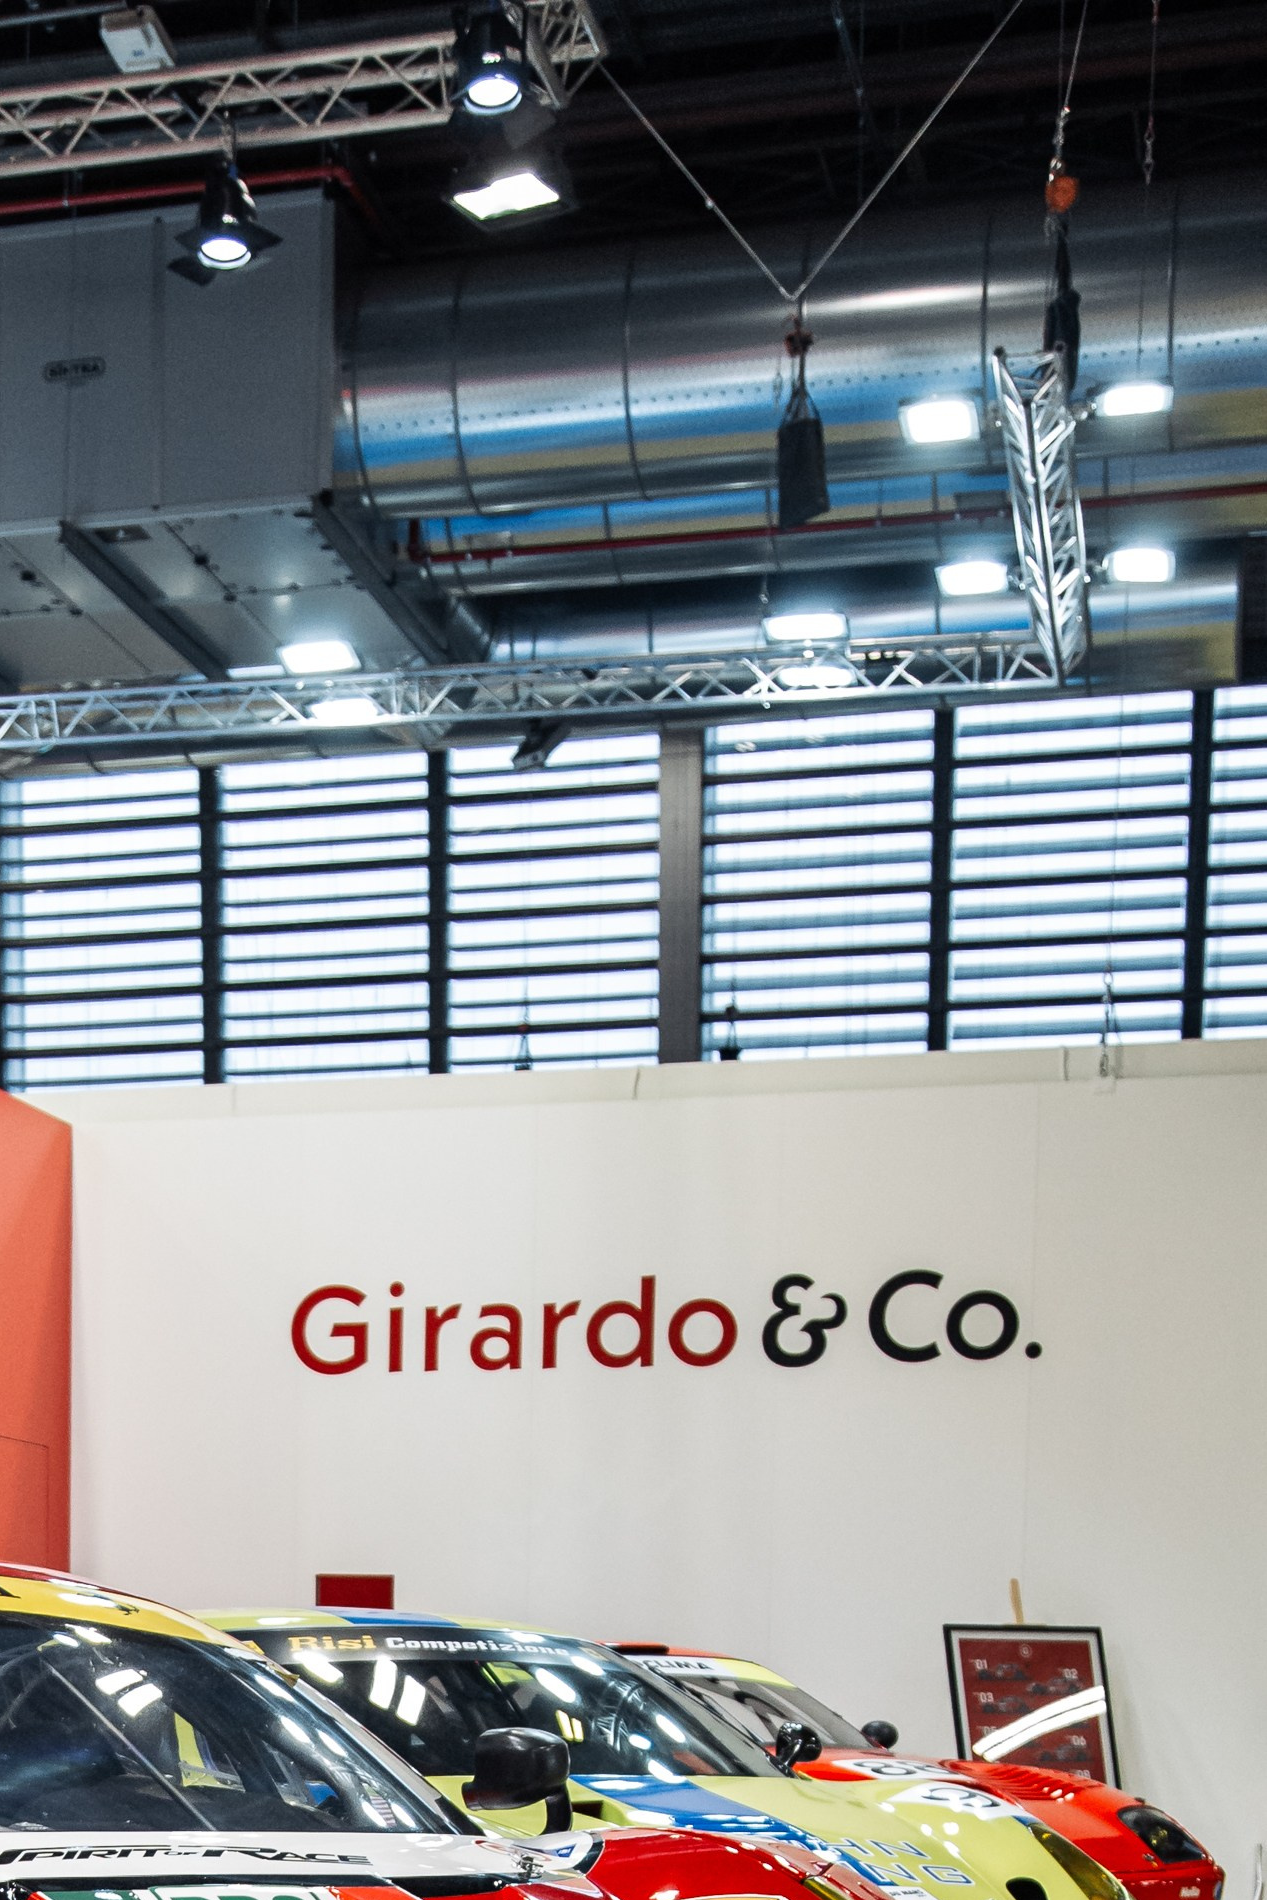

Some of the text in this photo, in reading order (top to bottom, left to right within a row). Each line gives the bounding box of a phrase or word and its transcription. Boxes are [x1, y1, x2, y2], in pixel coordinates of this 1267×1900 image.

[290, 1268, 1043, 1377] Girardo & Co.
[287, 1635, 570, 1657] Risi Competizione
